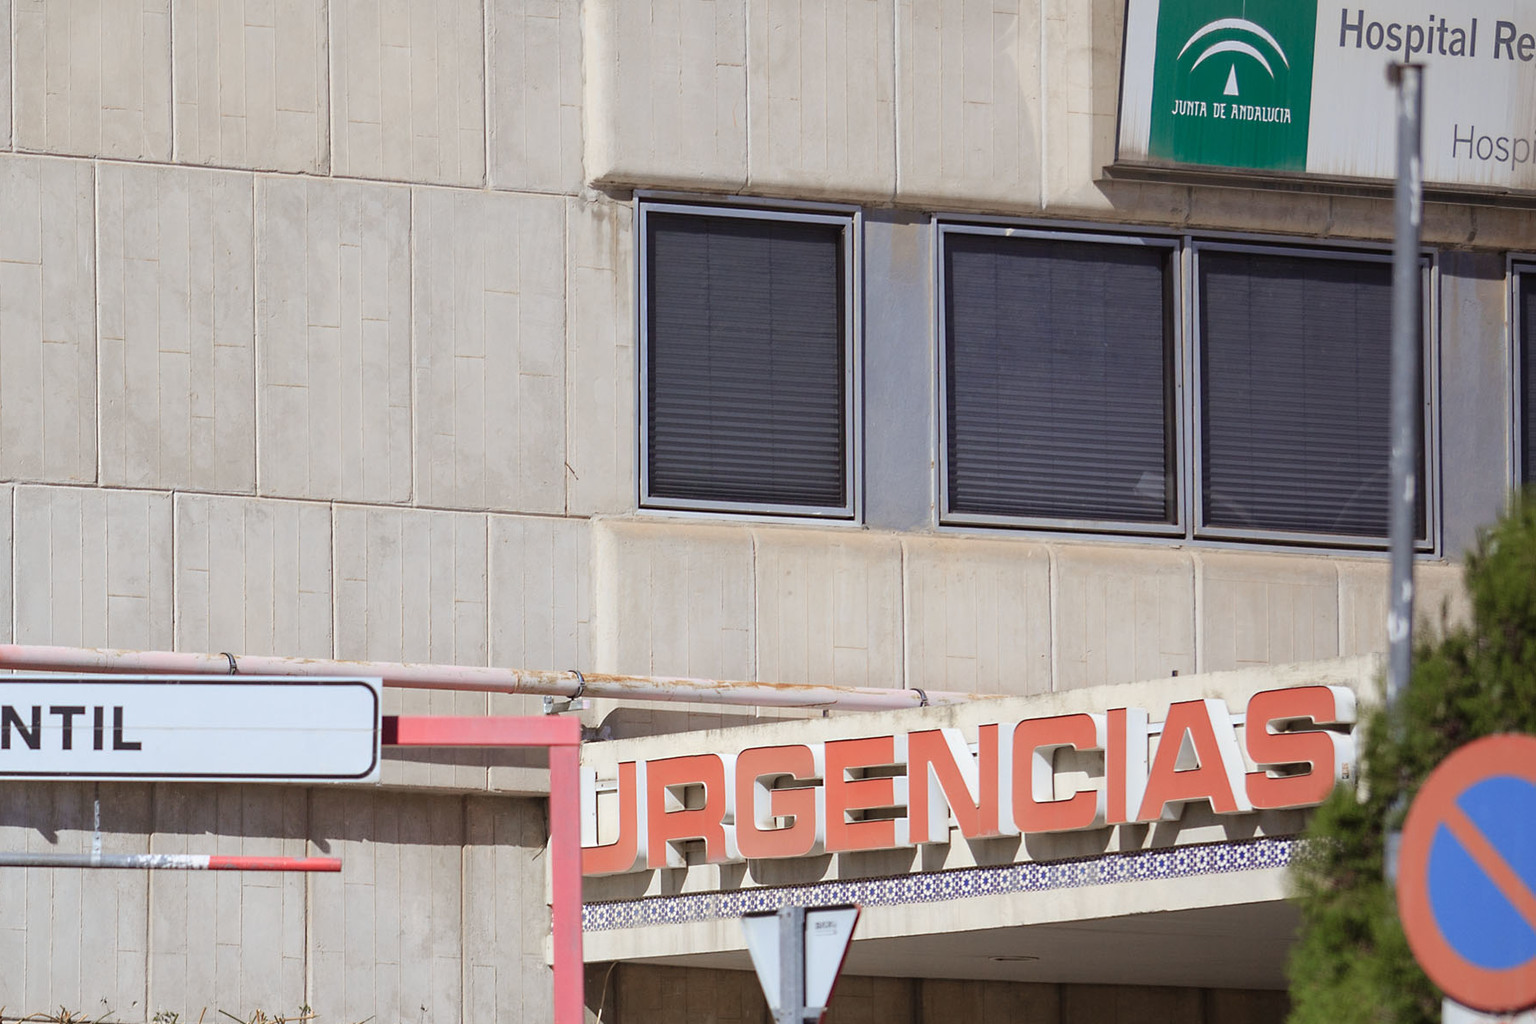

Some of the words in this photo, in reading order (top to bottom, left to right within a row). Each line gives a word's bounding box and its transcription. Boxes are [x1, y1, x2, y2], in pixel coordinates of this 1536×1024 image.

[1339, 8, 1478, 64] Hospital
[1171, 99, 1207, 118] JUNTA
[1213, 103, 1227, 119] DE
[1231, 104, 1292, 124] ANDALUCIA
[580, 685, 1356, 878] URGENCIAS
